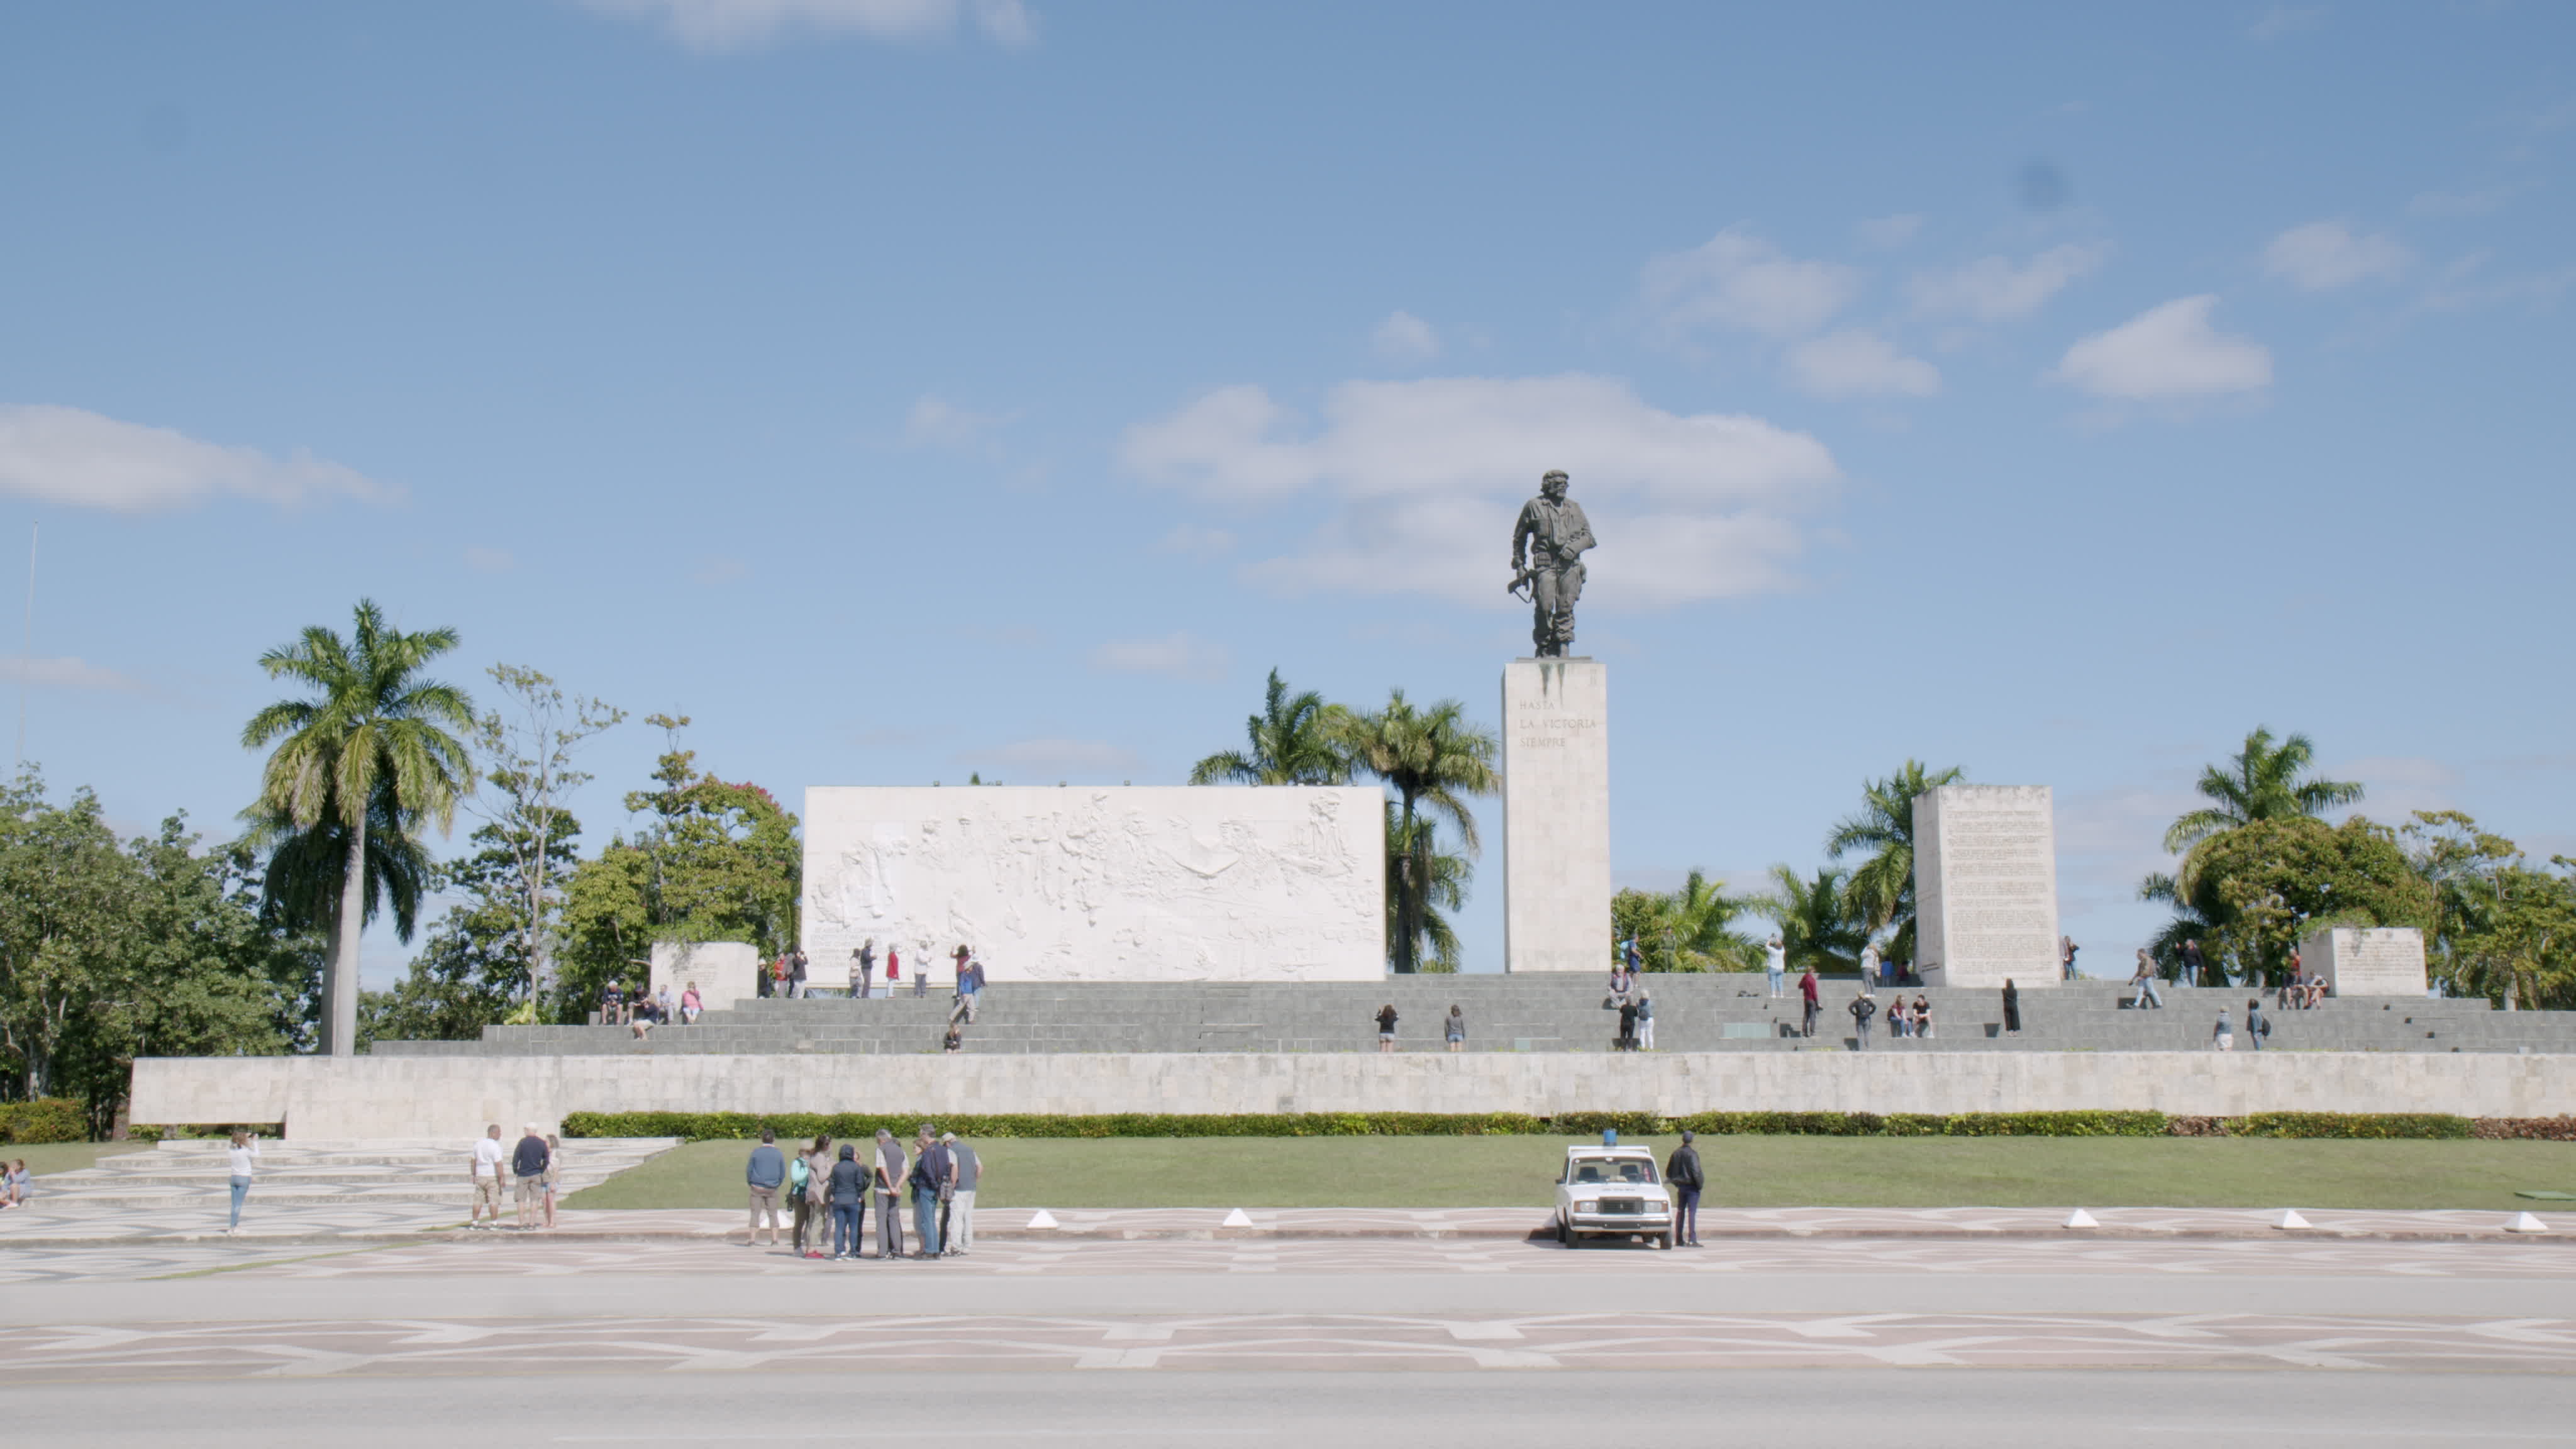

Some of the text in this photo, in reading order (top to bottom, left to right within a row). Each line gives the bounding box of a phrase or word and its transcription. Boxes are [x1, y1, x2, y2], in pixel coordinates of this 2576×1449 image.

[1519, 699, 1555, 710] HASTA
[1519, 719, 1596, 730] LA VICTORIA
[1519, 737, 1565, 747] SIEMPRE
